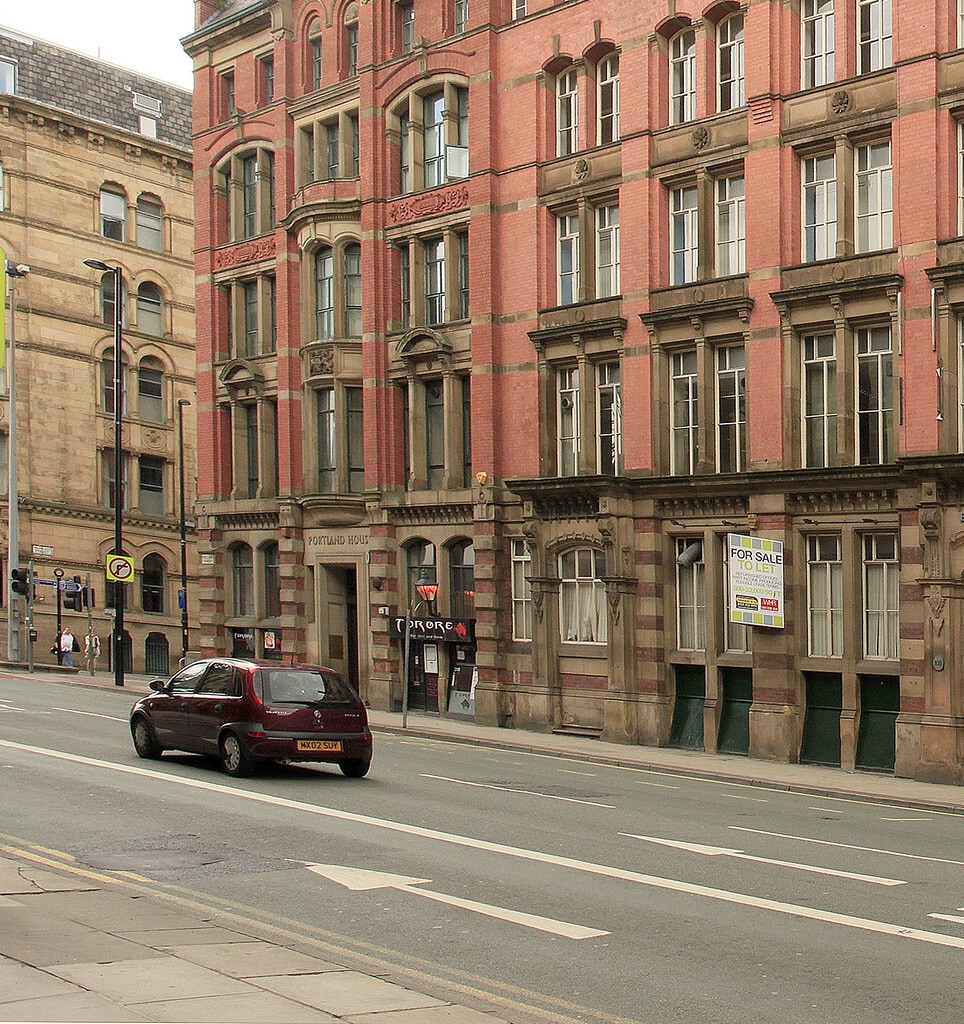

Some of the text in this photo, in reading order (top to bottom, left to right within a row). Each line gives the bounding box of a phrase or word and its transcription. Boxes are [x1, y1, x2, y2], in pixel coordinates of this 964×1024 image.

[308, 535, 371, 546] PORTLAND HOUS
[731, 548, 782, 565] FOR SALE
[738, 560, 776, 573] TO LET
[301, 741, 321, 750] MX02
